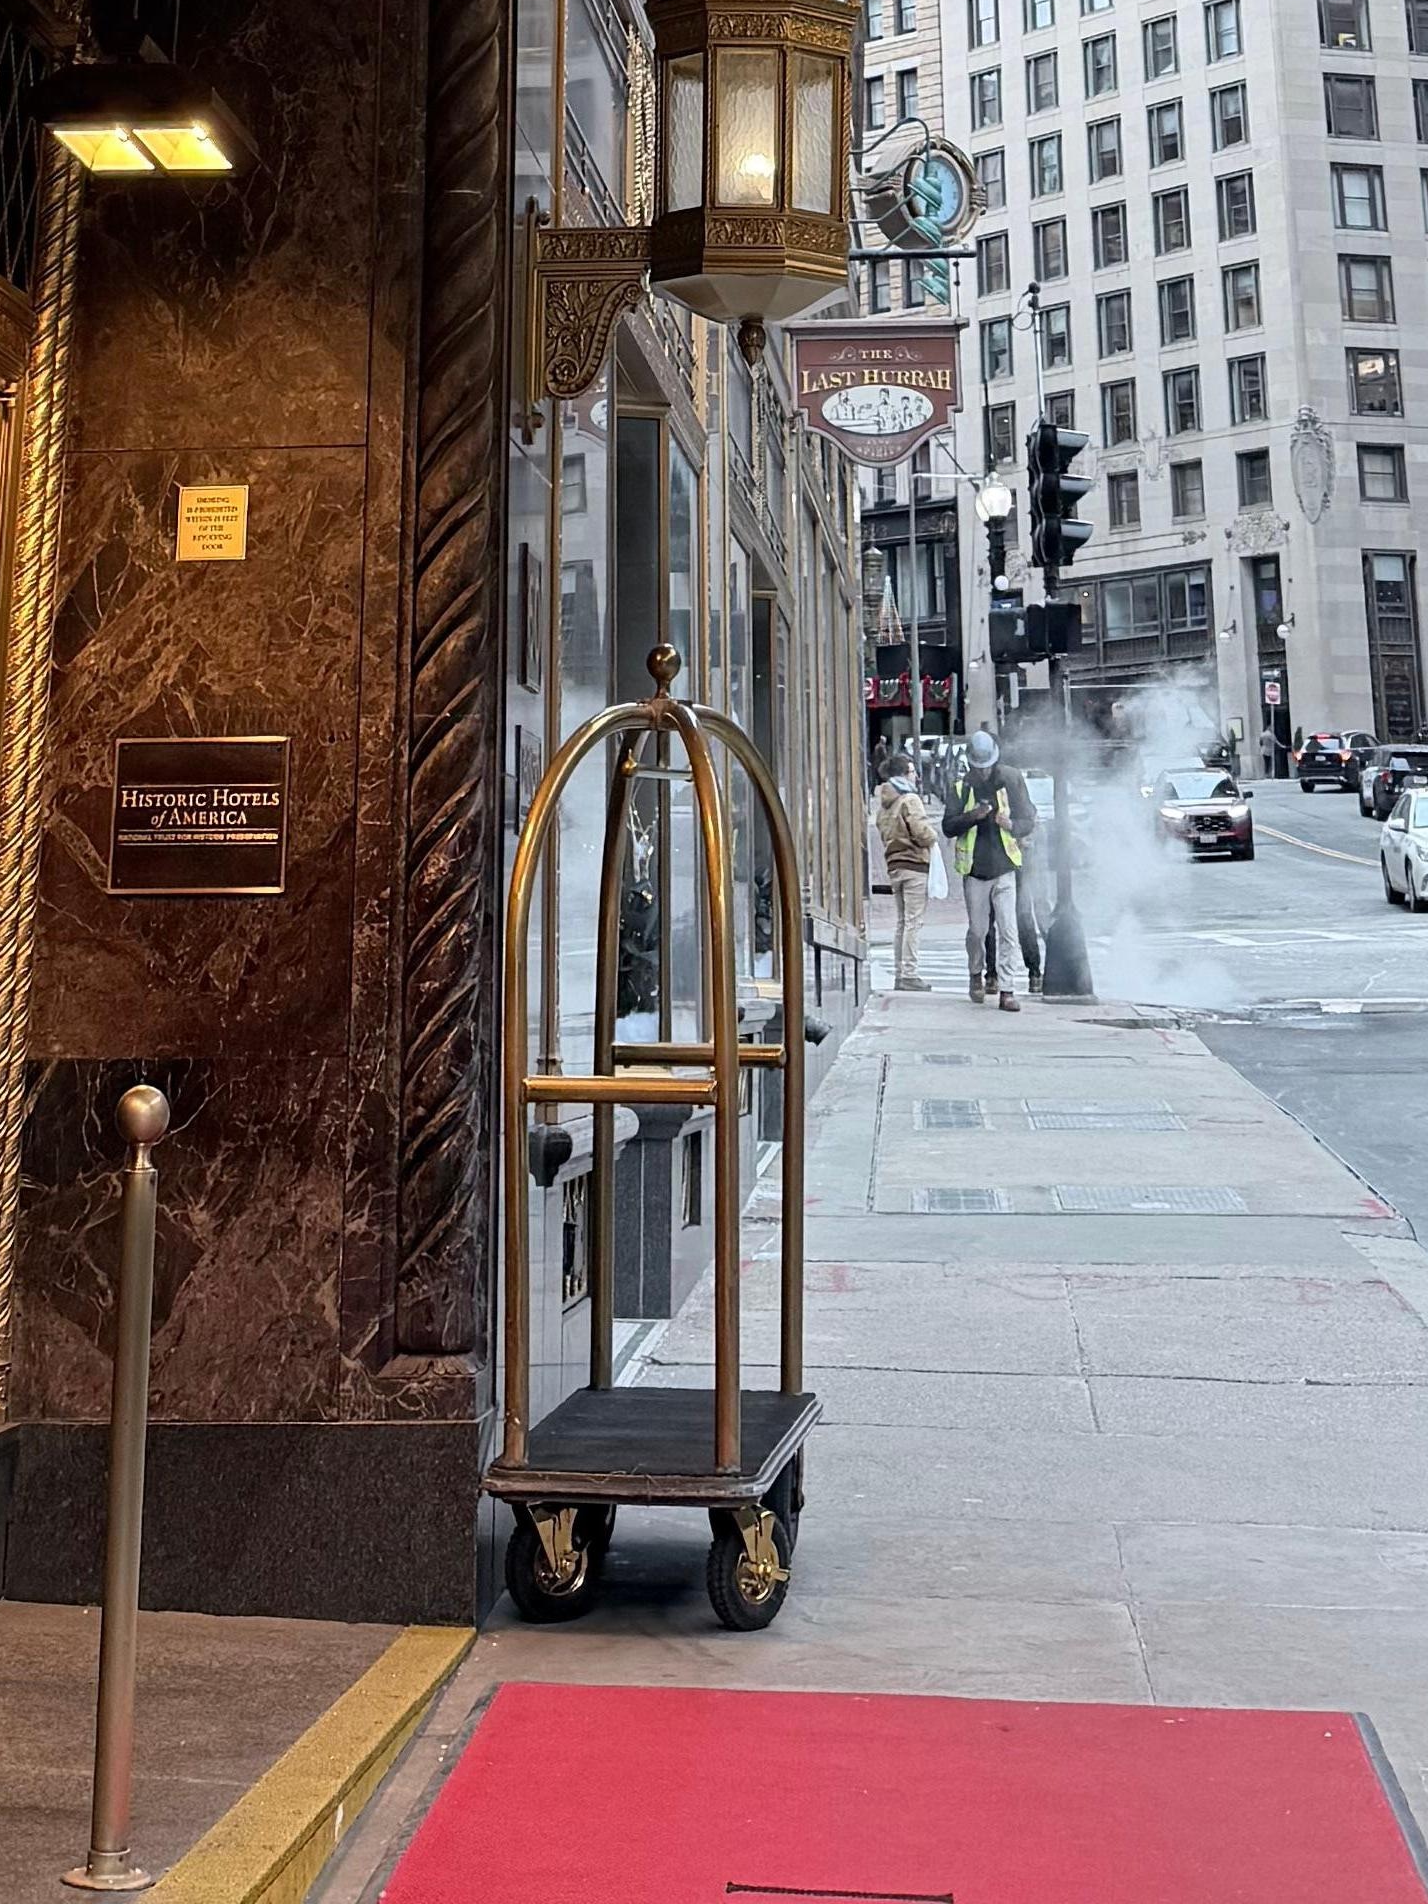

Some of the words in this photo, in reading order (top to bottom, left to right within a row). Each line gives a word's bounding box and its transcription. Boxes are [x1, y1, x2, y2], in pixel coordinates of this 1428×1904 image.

[860, 349, 892, 359] THE
[801, 370, 856, 394] LAST
[862, 368, 952, 391] HURRAH
[122, 790, 206, 808] HISTORIC
[213, 789, 280, 807] HOTELS
[151, 810, 167, 828] of
[169, 808, 247, 825] AMERICA
